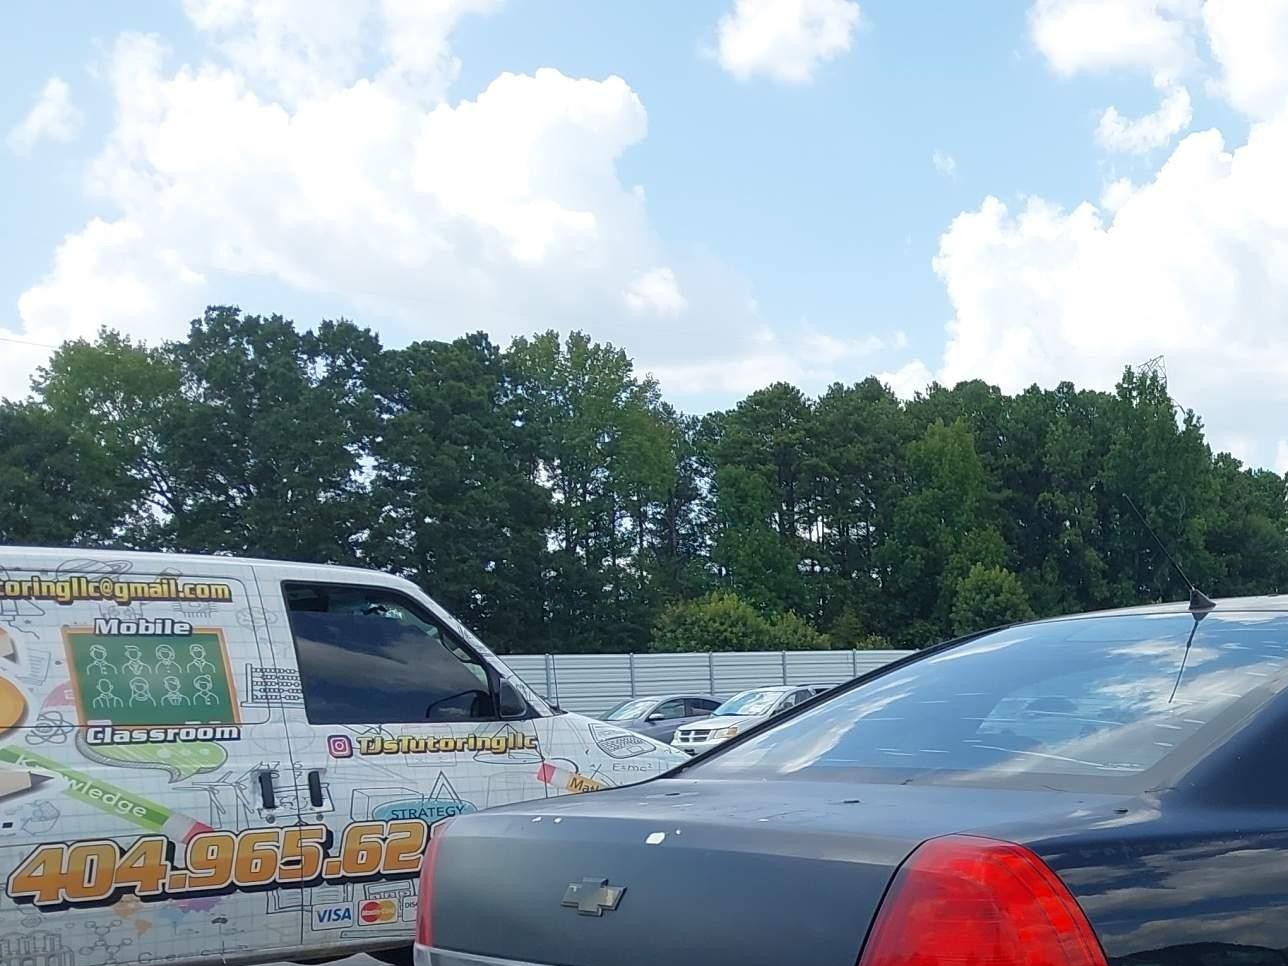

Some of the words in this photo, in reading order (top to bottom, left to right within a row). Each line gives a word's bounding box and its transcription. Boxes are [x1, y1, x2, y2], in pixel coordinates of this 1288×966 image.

[95, 618, 192, 635] Mobile
[86, 726, 240, 744] Classroom
[357, 732, 538, 754] TJsTutoringllc
[391, 805, 466, 819] STRATEGY
[8, 818, 450, 905] 404.965.62
[315, 907, 352, 923] VISA
